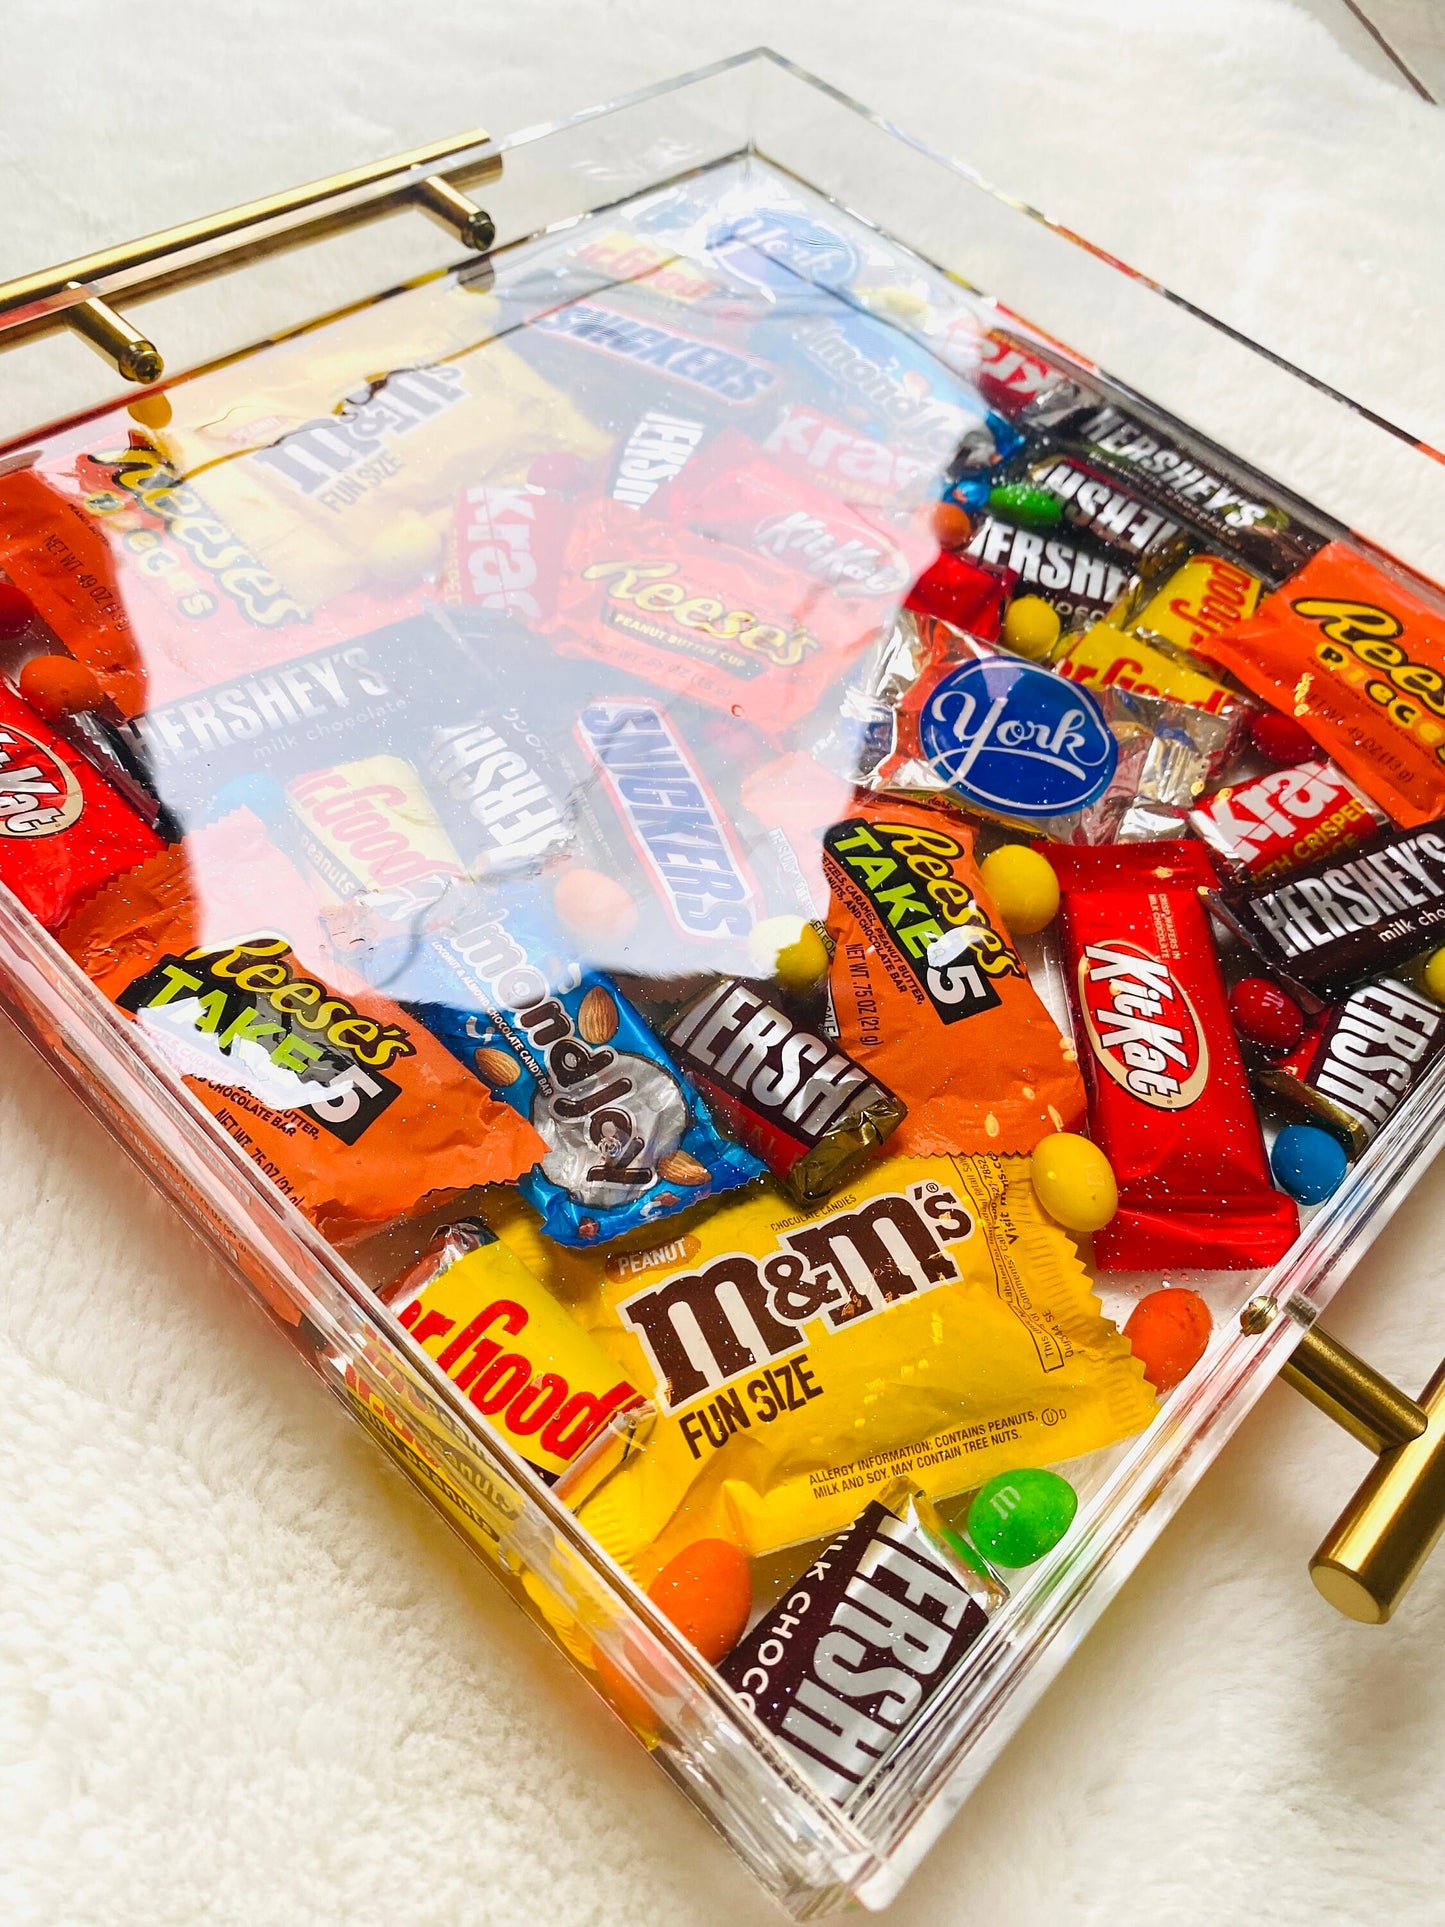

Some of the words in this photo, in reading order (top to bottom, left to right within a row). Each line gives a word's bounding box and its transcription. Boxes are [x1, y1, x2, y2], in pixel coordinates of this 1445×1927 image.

[546, 306, 778, 400] SNICKERS
[318, 470, 363, 514] FUN
[354, 450, 405, 495] SIZE
[1079, 407, 1266, 528] HERSHEY'S
[60, 552, 84, 575] WT
[582, 559, 822, 667] Reese's
[615, 614, 667, 640] PEANUT
[720, 653, 747, 668] CUP
[127, 646, 390, 764] HERSHEY'S
[252, 731, 299, 760] milk
[305, 700, 411, 740] chocolate
[929, 691, 1100, 788] York
[580, 705, 748, 938] SNICKERS
[1293, 798, 1370, 858] CRISPED
[833, 825, 943, 961] TAKE
[924, 958, 988, 1007] 5
[873, 821, 1022, 978] Reese's
[1158, 893, 1171, 916] CRISP
[1250, 832, 1445, 958] HERSHEY'S
[842, 898, 864, 920] AND
[858, 917, 894, 972] CHOCOLATE
[890, 970, 908, 994] BAR
[845, 942, 865, 962] NET
[1152, 912, 1170, 960] CHOCOLATE
[1164, 916, 1179, 950] WAFERS
[1378, 917, 1418, 943] milk
[849, 962, 869, 981] WT
[853, 979, 873, 998] .75
[874, 926, 901, 965] PEANUT
[898, 964, 927, 1005] BUTTER,
[187, 931, 412, 1068] Reese's
[857, 998, 877, 1016] OZ
[857, 1015, 881, 1033] (21
[1084, 945, 1180, 1098] KitKat
[460, 974, 491, 1008] ALMOND
[485, 1004, 525, 1052] CHOCOLATE
[518, 1049, 544, 1080] CANDY
[536, 1077, 555, 1098] BAR
[859, 1034, 884, 1048] g)
[207, 1080, 272, 1122] CHOCOLATE
[271, 1117, 297, 1137] BAR
[770, 1206, 821, 1232] CHOCOLATE
[821, 1193, 857, 1219] CANDIES
[1000, 1212, 1020, 1245] Visit
[617, 1238, 688, 1276] PEANUT
[1041, 1336, 1054, 1357] This
[679, 1389, 752, 1460] FUN
[754, 1354, 825, 1423] SIZE
[808, 1463, 856, 1485] ALLERGY
[857, 1439, 934, 1471] INFORMATION:
[935, 1424, 986, 1448] CONTAINS
[988, 1410, 1039, 1432] PEANUTS,
[813, 1482, 840, 1499] MILK
[841, 1475, 865, 1492] AND
[866, 1466, 891, 1484] SOY.
[890, 1459, 915, 1476] MAY
[916, 1445, 962, 1468] CONTAIN
[963, 1437, 989, 1454] TREE
[990, 1428, 1022, 1446] NUTS.
